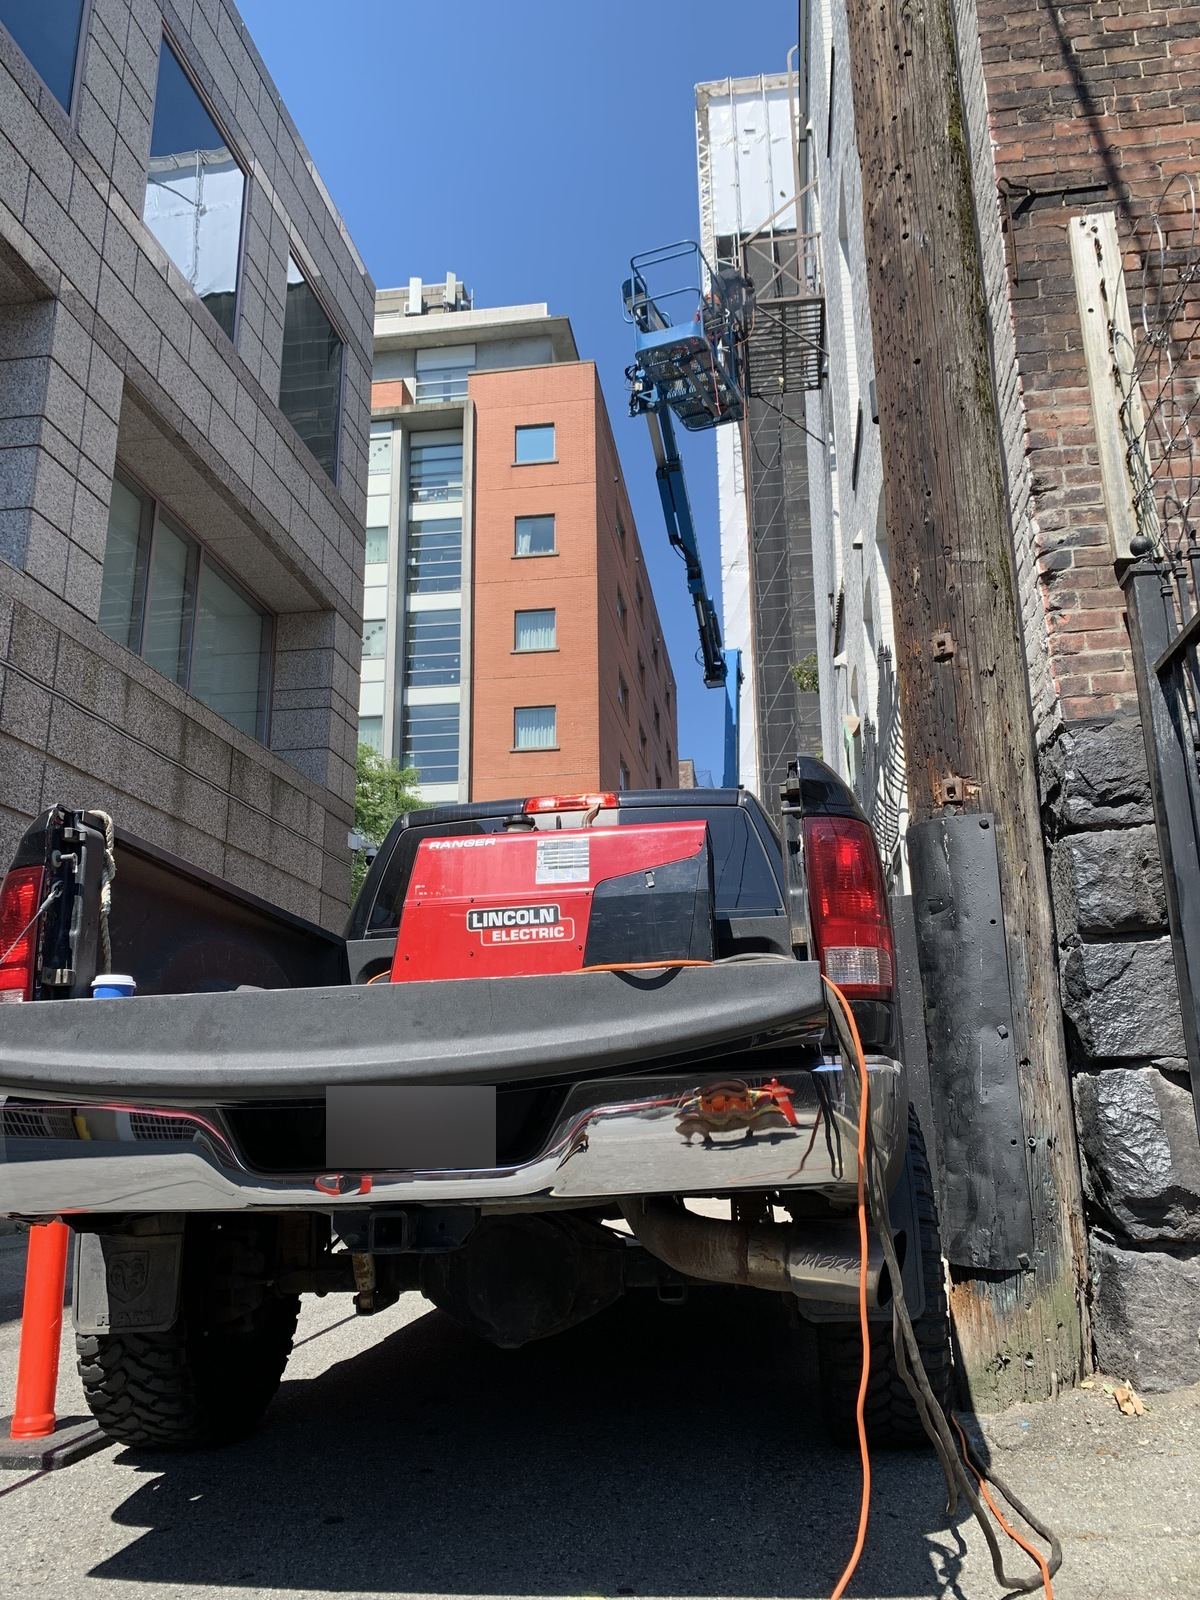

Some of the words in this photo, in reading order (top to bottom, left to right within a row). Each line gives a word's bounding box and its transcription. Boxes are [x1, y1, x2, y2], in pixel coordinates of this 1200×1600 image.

[429, 838, 496, 850] RANGER
[472, 908, 555, 928] LINCOLN
[492, 926, 565, 942] ELECTRIC
